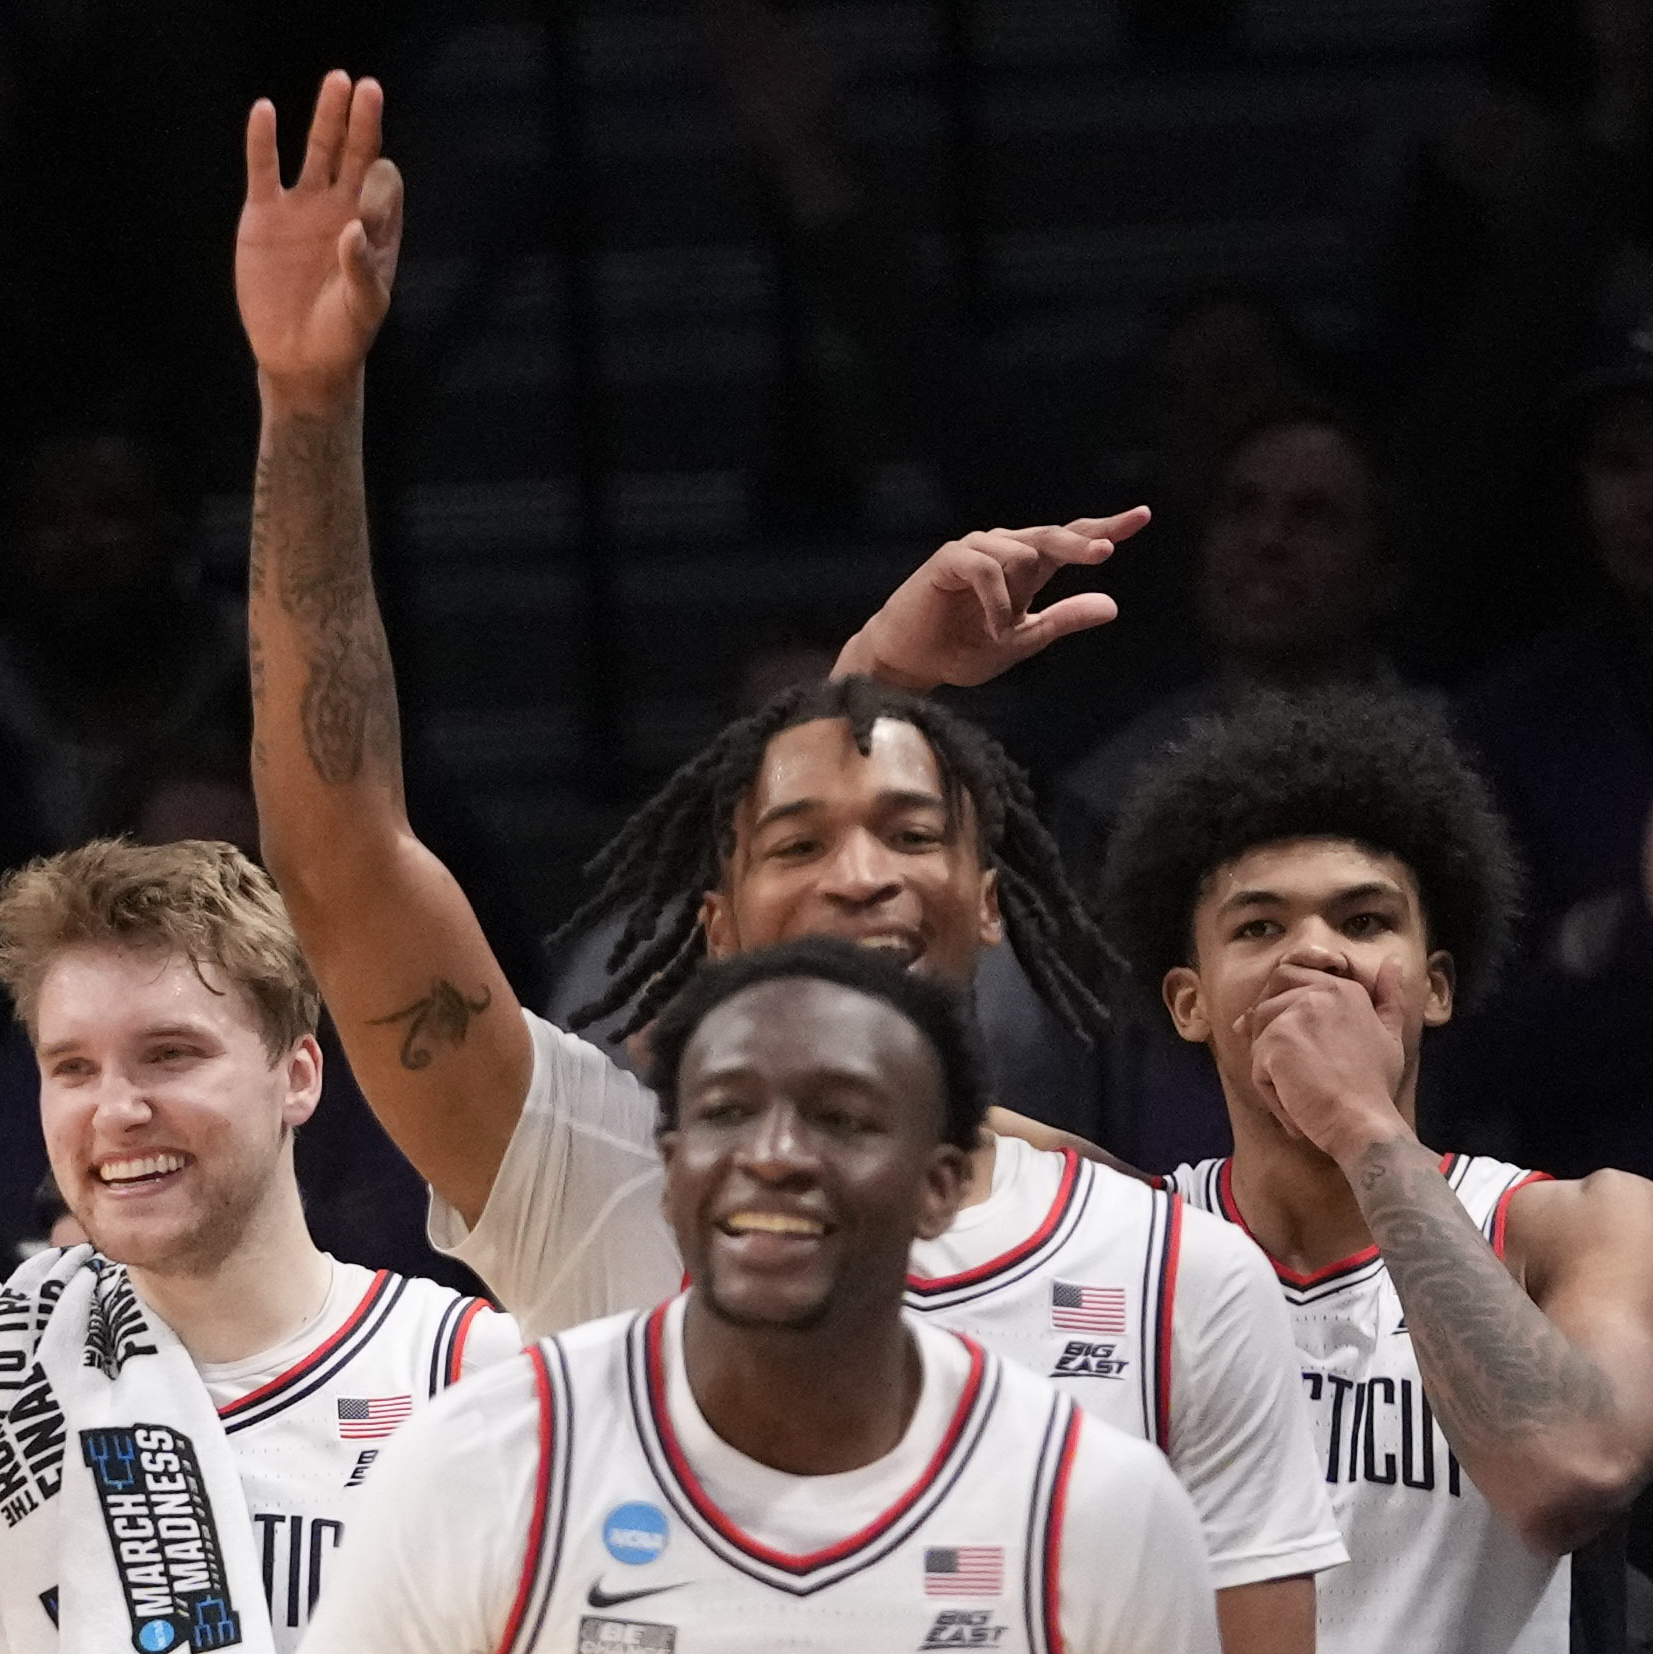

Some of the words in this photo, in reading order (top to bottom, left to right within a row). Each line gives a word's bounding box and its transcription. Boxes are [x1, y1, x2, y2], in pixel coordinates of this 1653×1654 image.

[1054, 1356, 1130, 1375] EAST
[1063, 1340, 1117, 1358] BIG
[0, 1488, 40, 1528] THE
[135, 1428, 212, 1593] MADNESS
[106, 1493, 174, 1618] MARCH
